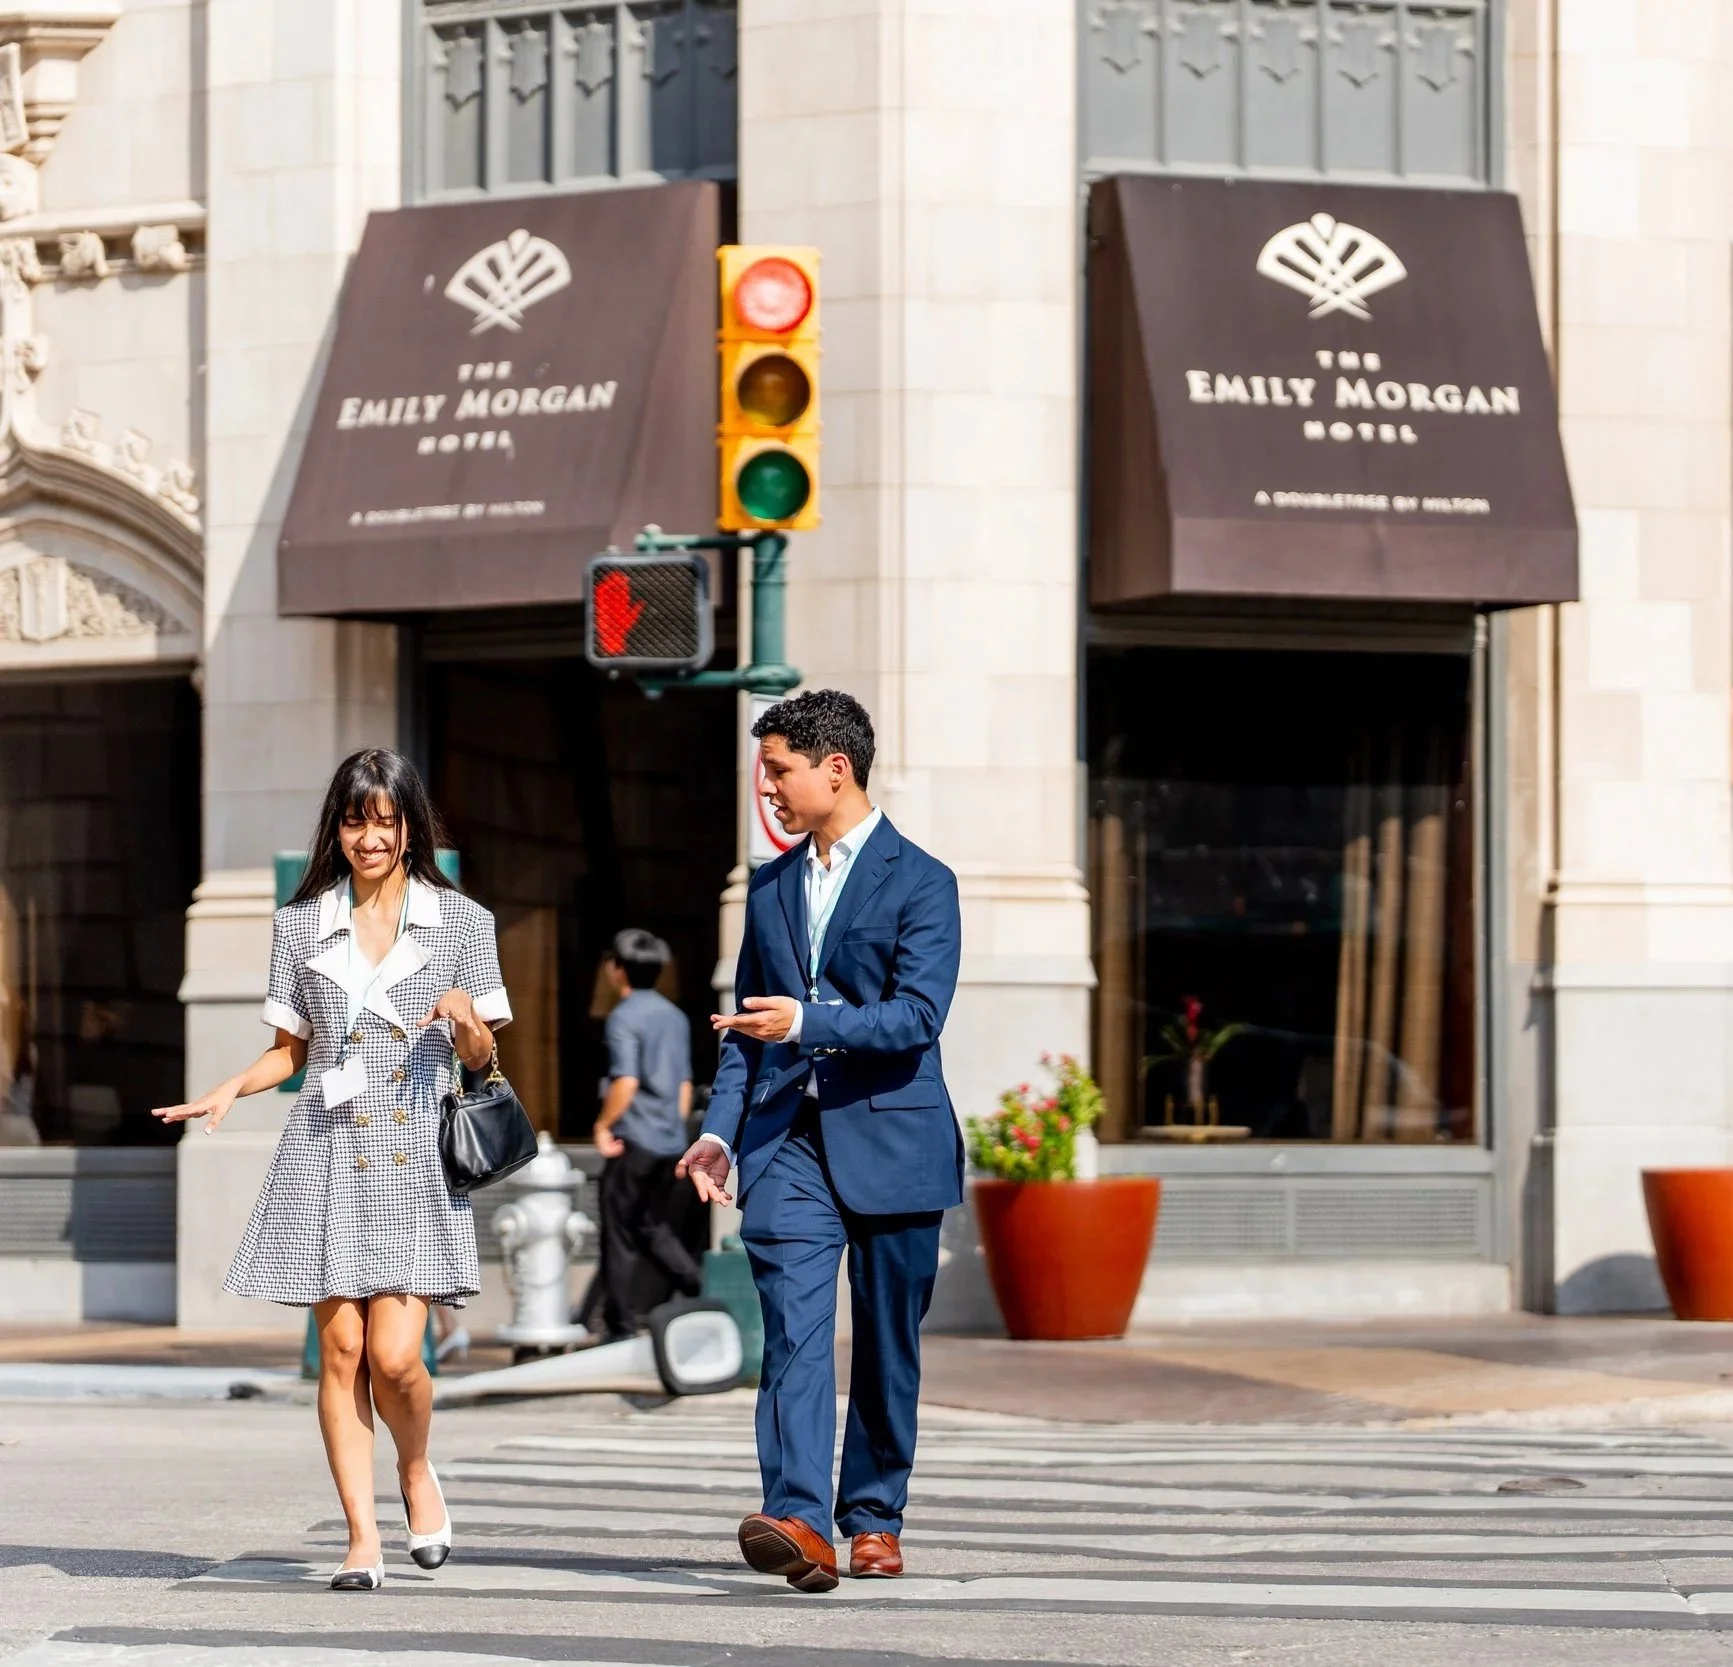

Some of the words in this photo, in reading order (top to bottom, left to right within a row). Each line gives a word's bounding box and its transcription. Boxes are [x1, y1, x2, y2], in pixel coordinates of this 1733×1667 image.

[458, 360, 512, 382] THE
[1316, 349, 1382, 371] THE
[1186, 369, 1316, 407] EMILY
[1335, 376, 1521, 415] MORGAN
[336, 395, 447, 430] EMILY
[455, 380, 618, 421] MORGAN
[417, 430, 512, 455] HOTEL
[1303, 421, 1418, 444] HOTEL
[1254, 490, 1271, 506] A
[1392, 495, 1418, 513] BY
